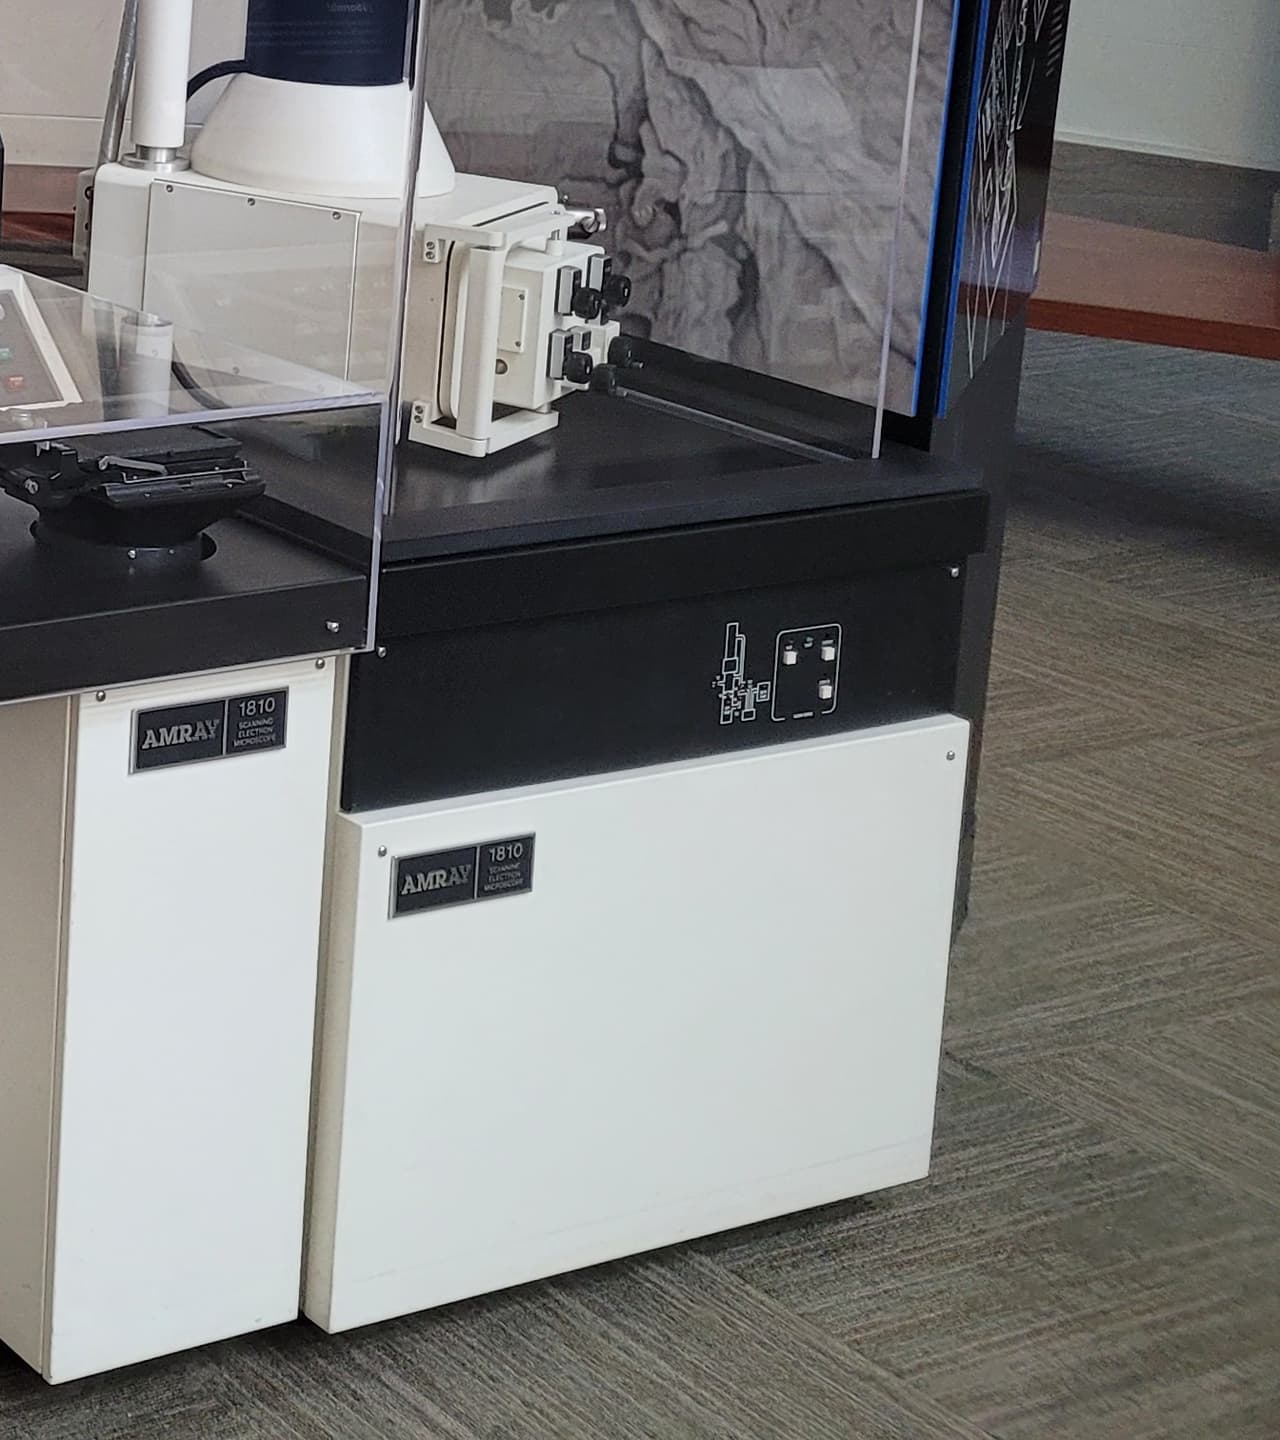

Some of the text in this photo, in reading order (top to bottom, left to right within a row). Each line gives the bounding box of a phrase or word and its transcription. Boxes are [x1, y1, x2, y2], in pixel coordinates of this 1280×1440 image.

[239, 697, 276, 717] 1810
[238, 717, 274, 729] SCANNING
[142, 719, 219, 750] AMRAY
[234, 734, 276, 747] MICROSCOPE
[238, 727, 273, 738] ELECTRON
[489, 843, 524, 863] 1810
[401, 864, 472, 895] AMRAY
[488, 871, 521, 882] ELECTRON
